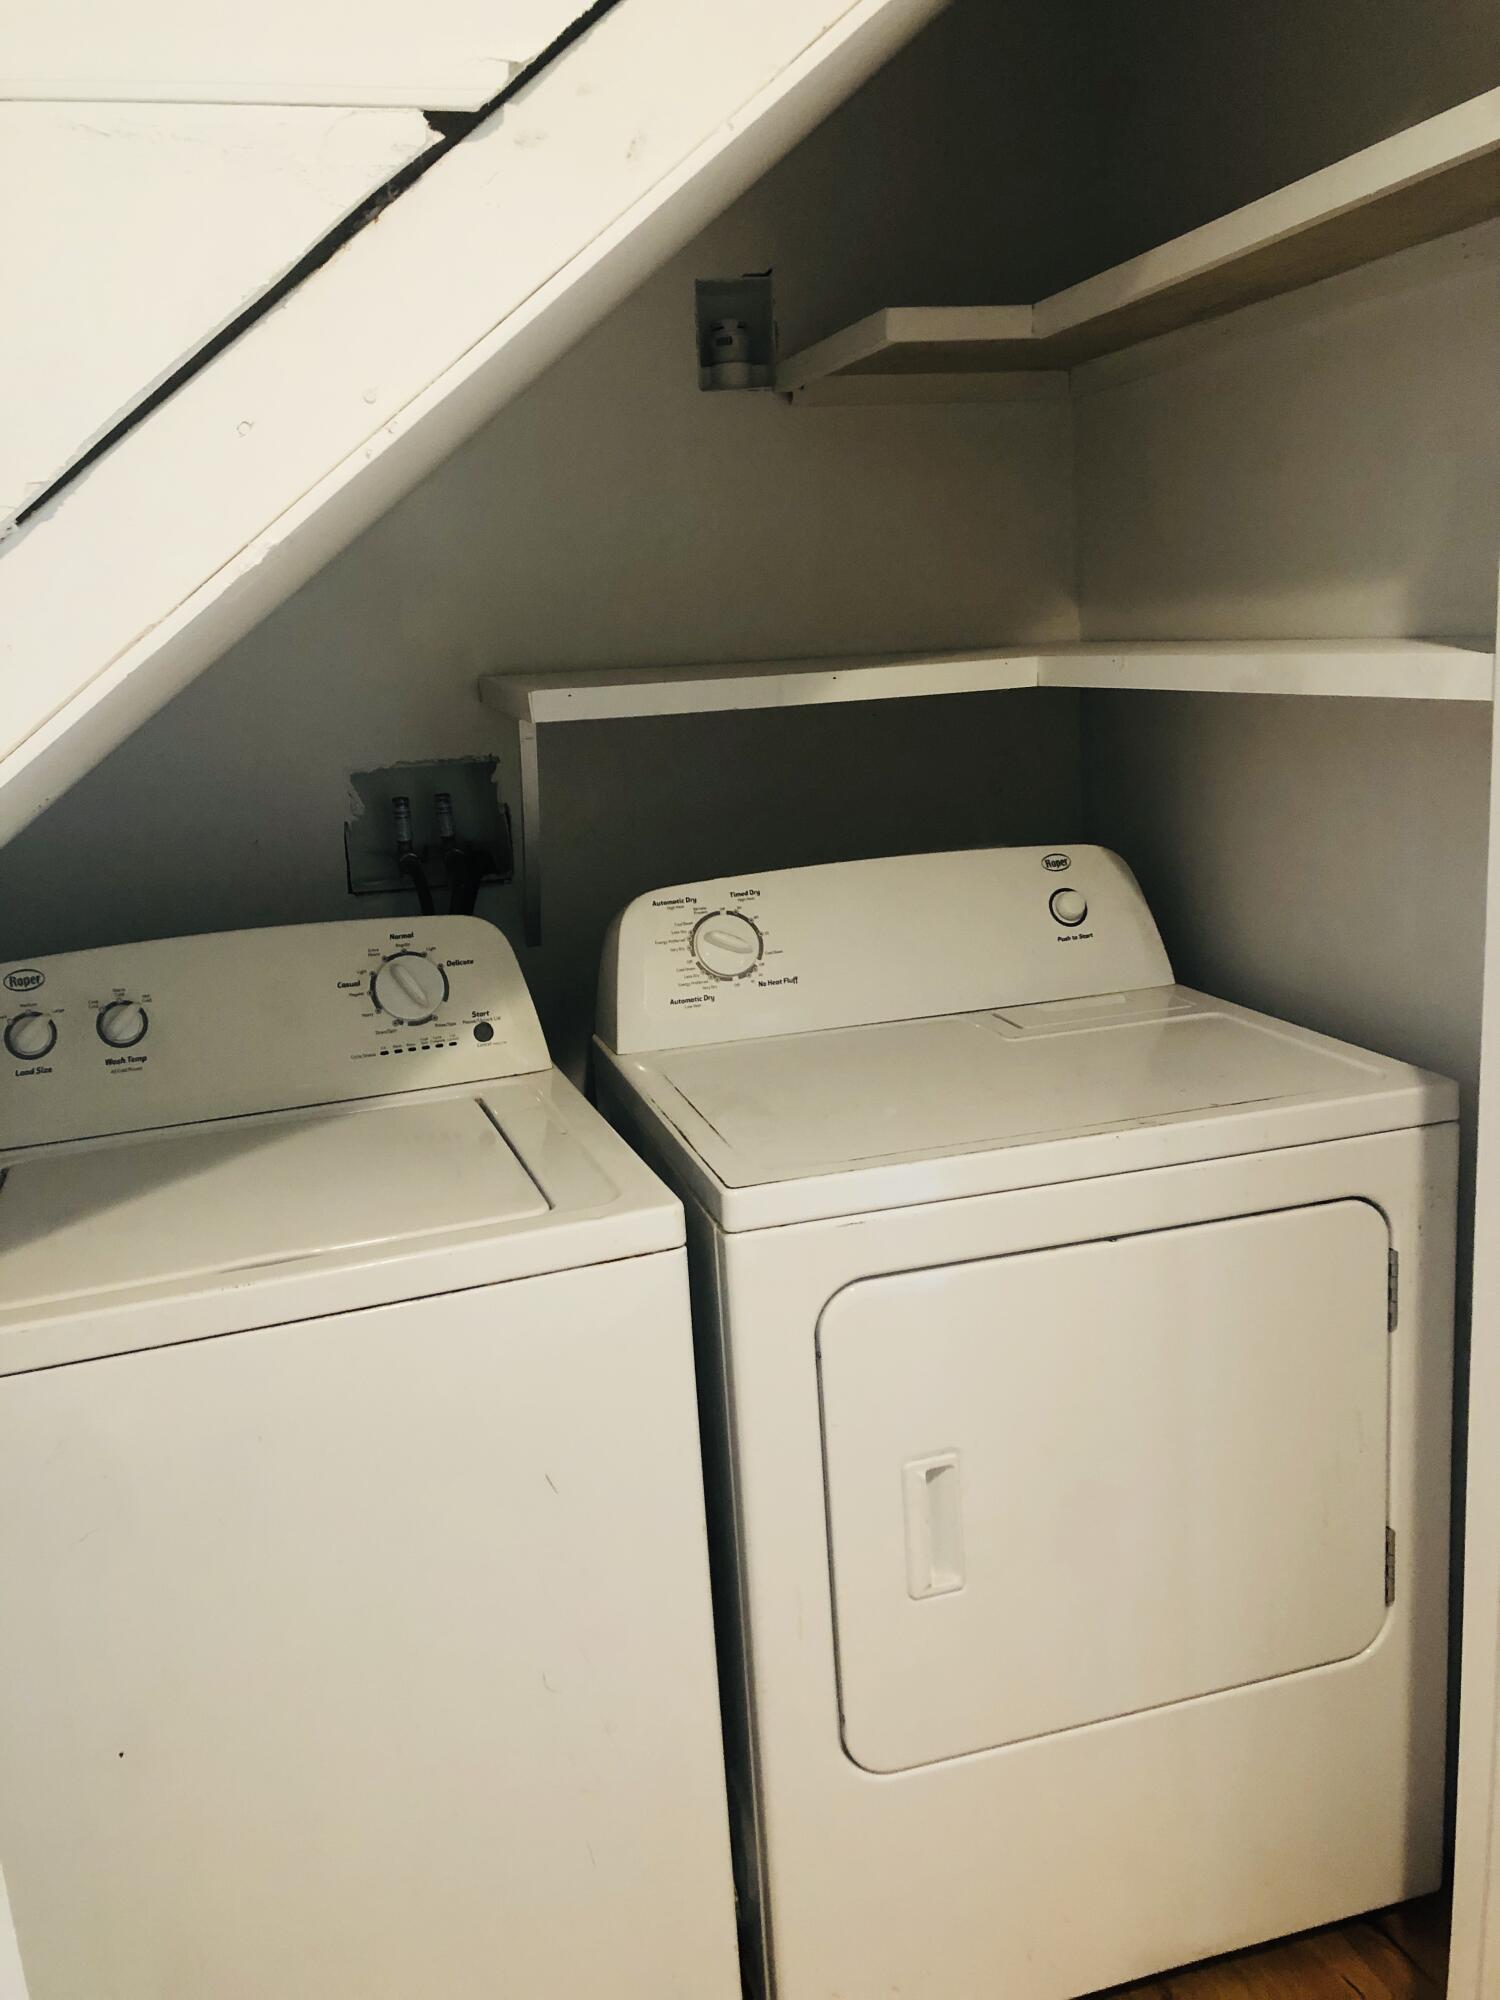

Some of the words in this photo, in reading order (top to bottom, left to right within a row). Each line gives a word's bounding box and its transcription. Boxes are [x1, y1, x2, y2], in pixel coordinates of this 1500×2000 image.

[749, 889, 761, 897] Dry
[652, 898, 684, 907] Automatic
[685, 896, 697, 904] Dry
[389, 931, 414, 941] Normal
[1079, 932, 1093, 940] Start
[446, 959, 474, 967] Delicate
[9, 975, 40, 988] Roper
[337, 980, 361, 989] Casual
[670, 995, 702, 1005] Automatic
[703, 994, 715, 1002] Dry
[472, 1010, 490, 1018] Start
[105, 1057, 126, 1066] Wash
[127, 1055, 147, 1063] Temp
[15, 1068, 35, 1077] Load
[36, 1066, 53, 1075] Size
